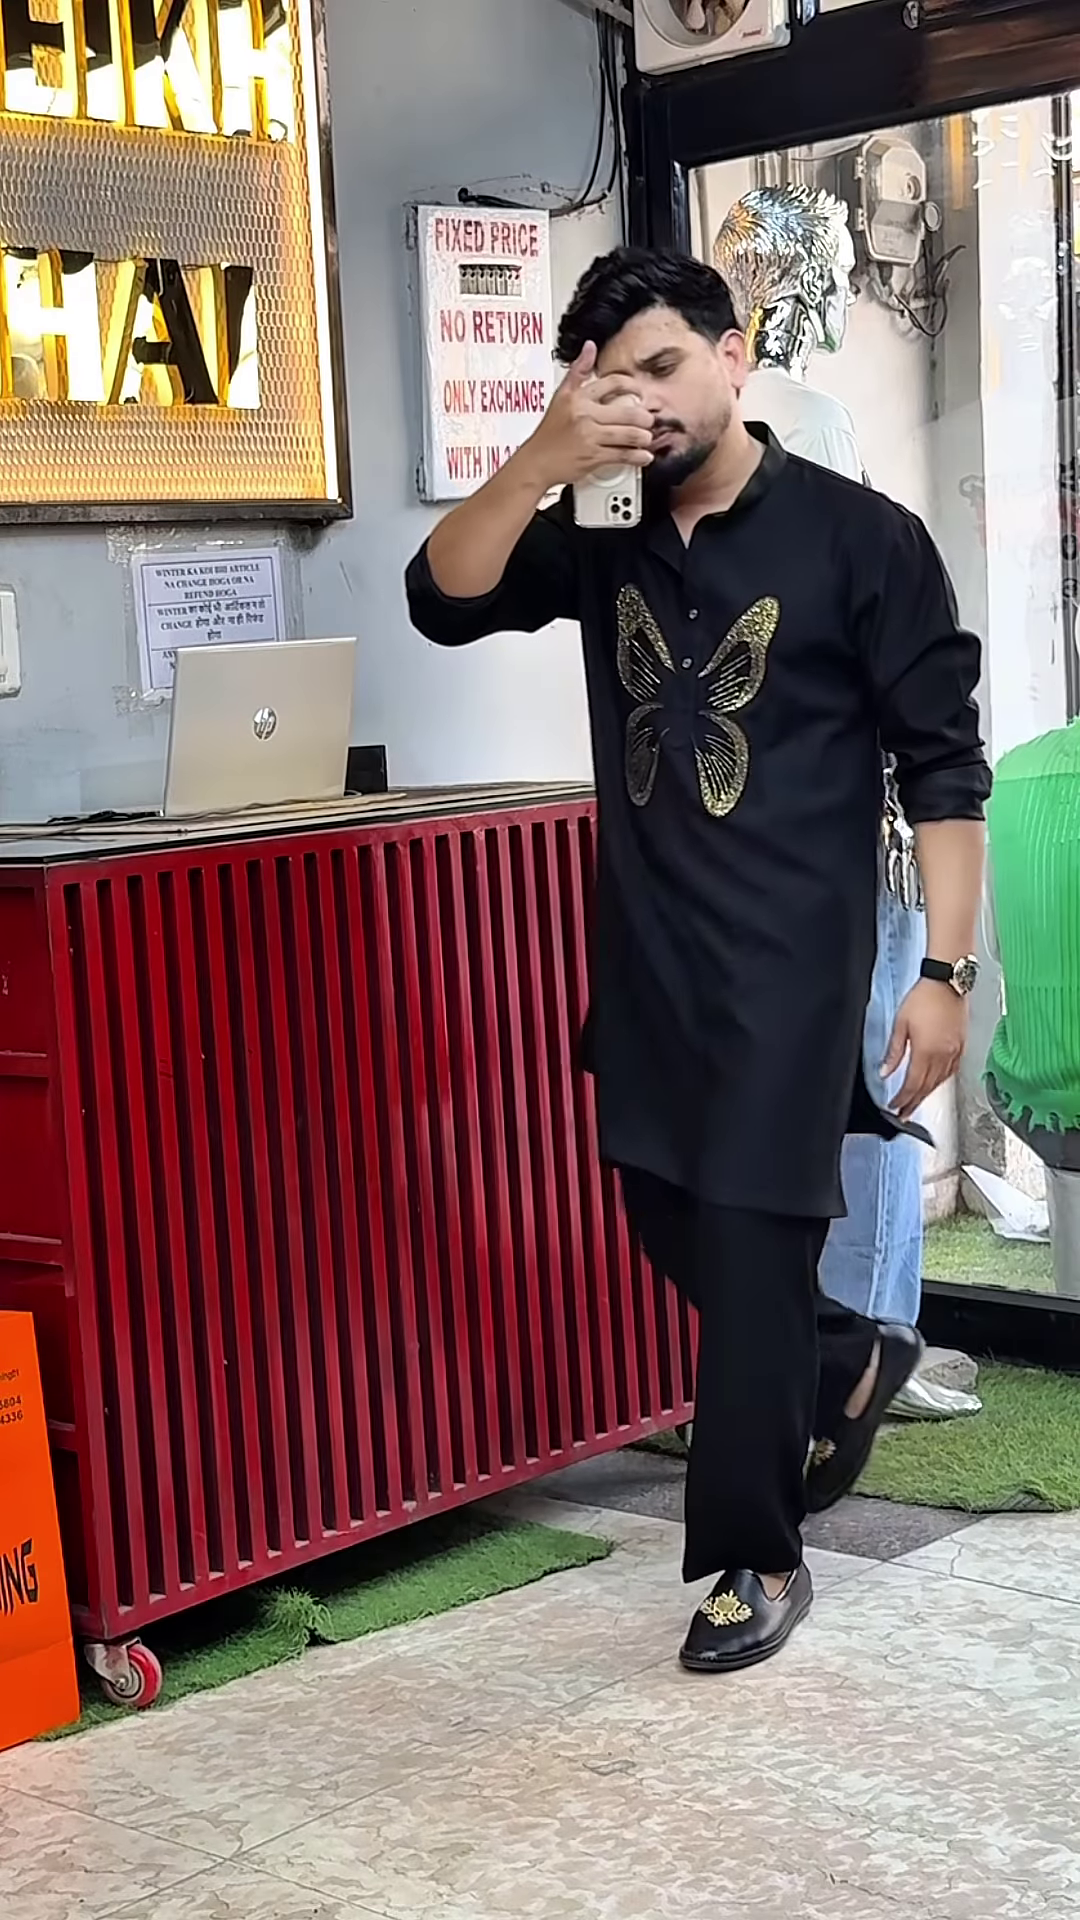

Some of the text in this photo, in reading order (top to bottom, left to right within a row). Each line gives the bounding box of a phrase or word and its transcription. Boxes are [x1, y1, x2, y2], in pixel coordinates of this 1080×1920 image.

[435, 218, 539, 257] FIXED PRICE
[440, 310, 543, 344] NO RETURN
[444, 379, 544, 413] ONLY EXCHANGE
[445, 446, 482, 479] WITH
[487, 445, 500, 478] IN
[156, 568, 185, 577] WINTER
[229, 563, 260, 572] ARTICLE
[177, 579, 207, 588] CHANGE
[184, 590, 214, 599] REFUND
[157, 607, 187, 616] WINTER
[160, 620, 192, 630] CHANGE
